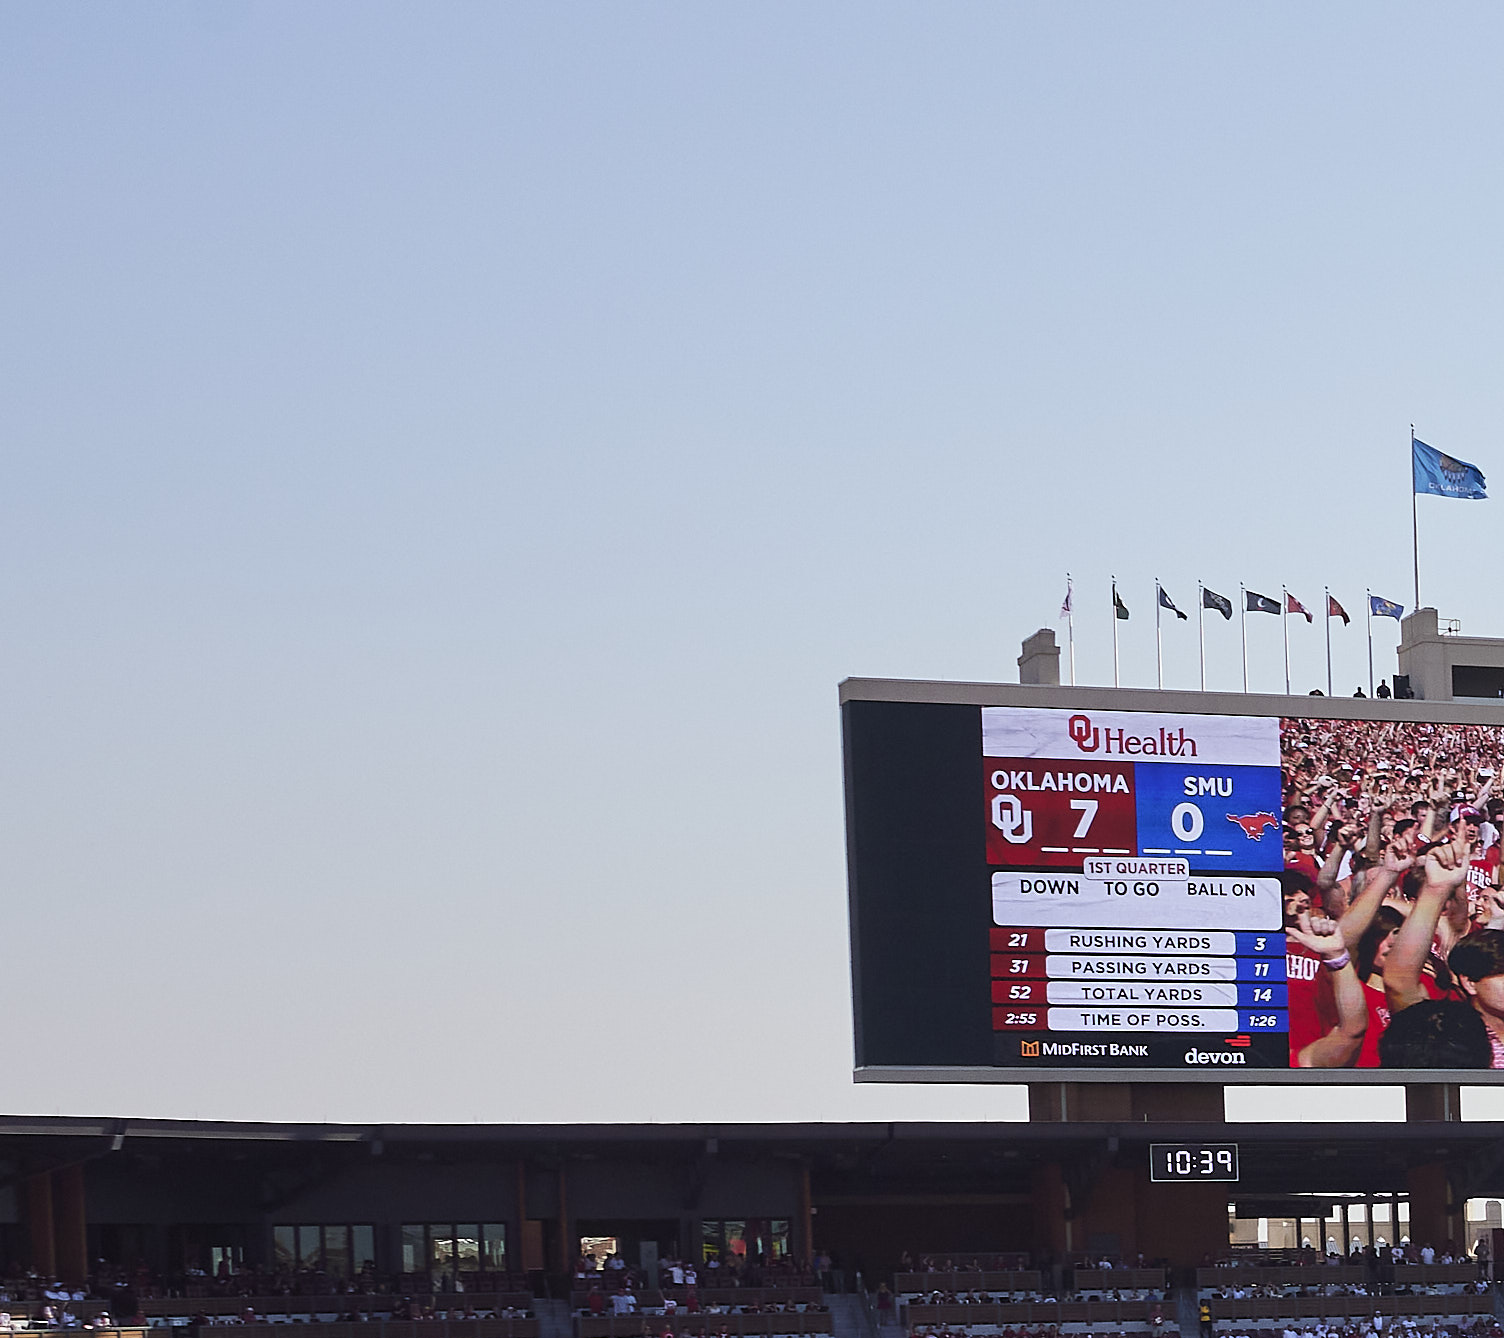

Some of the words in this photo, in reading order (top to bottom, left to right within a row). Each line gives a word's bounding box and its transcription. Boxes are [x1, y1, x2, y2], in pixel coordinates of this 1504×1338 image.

[1105, 727, 1198, 756] Health
[991, 771, 1129, 793] OKLAHOMA
[1184, 777, 1233, 796] SMU
[992, 794, 1033, 843] OU
[1069, 800, 1099, 838] 7
[1171, 802, 1204, 841] 0
[1089, 861, 1113, 873] 1ST
[1117, 862, 1186, 875] QUARTER
[1020, 880, 1079, 895] DOWN
[1104, 882, 1125, 896] TO
[1128, 882, 1159, 897] GO
[1188, 882, 1227, 896] BALL
[1232, 883, 1255, 897] ON
[1009, 933, 1028, 947] 21
[1070, 935, 1147, 948] RUSHING
[1153, 937, 1211, 949] YARDS
[1255, 938, 1265, 950] 3
[1010, 960, 1029, 973] 31
[1072, 961, 1146, 974] PASSING
[1153, 962, 1210, 975] YARDS
[1255, 964, 1269, 976] 11
[1009, 986, 1032, 999] 52
[1082, 988, 1138, 999] TOTAL
[1145, 988, 1202, 1001] YARDS
[1254, 989, 1272, 1002] 14
[1005, 1012, 1037, 1025] 2:55
[1081, 1014, 1122, 1025] TIME
[1128, 1014, 1149, 1026] OF
[1157, 1014, 1205, 1026] POSS.
[1250, 1015, 1276, 1027] 1:26
[1185, 1047, 1245, 1064] devon
[1167, 1150, 1231, 1173] 10:39
